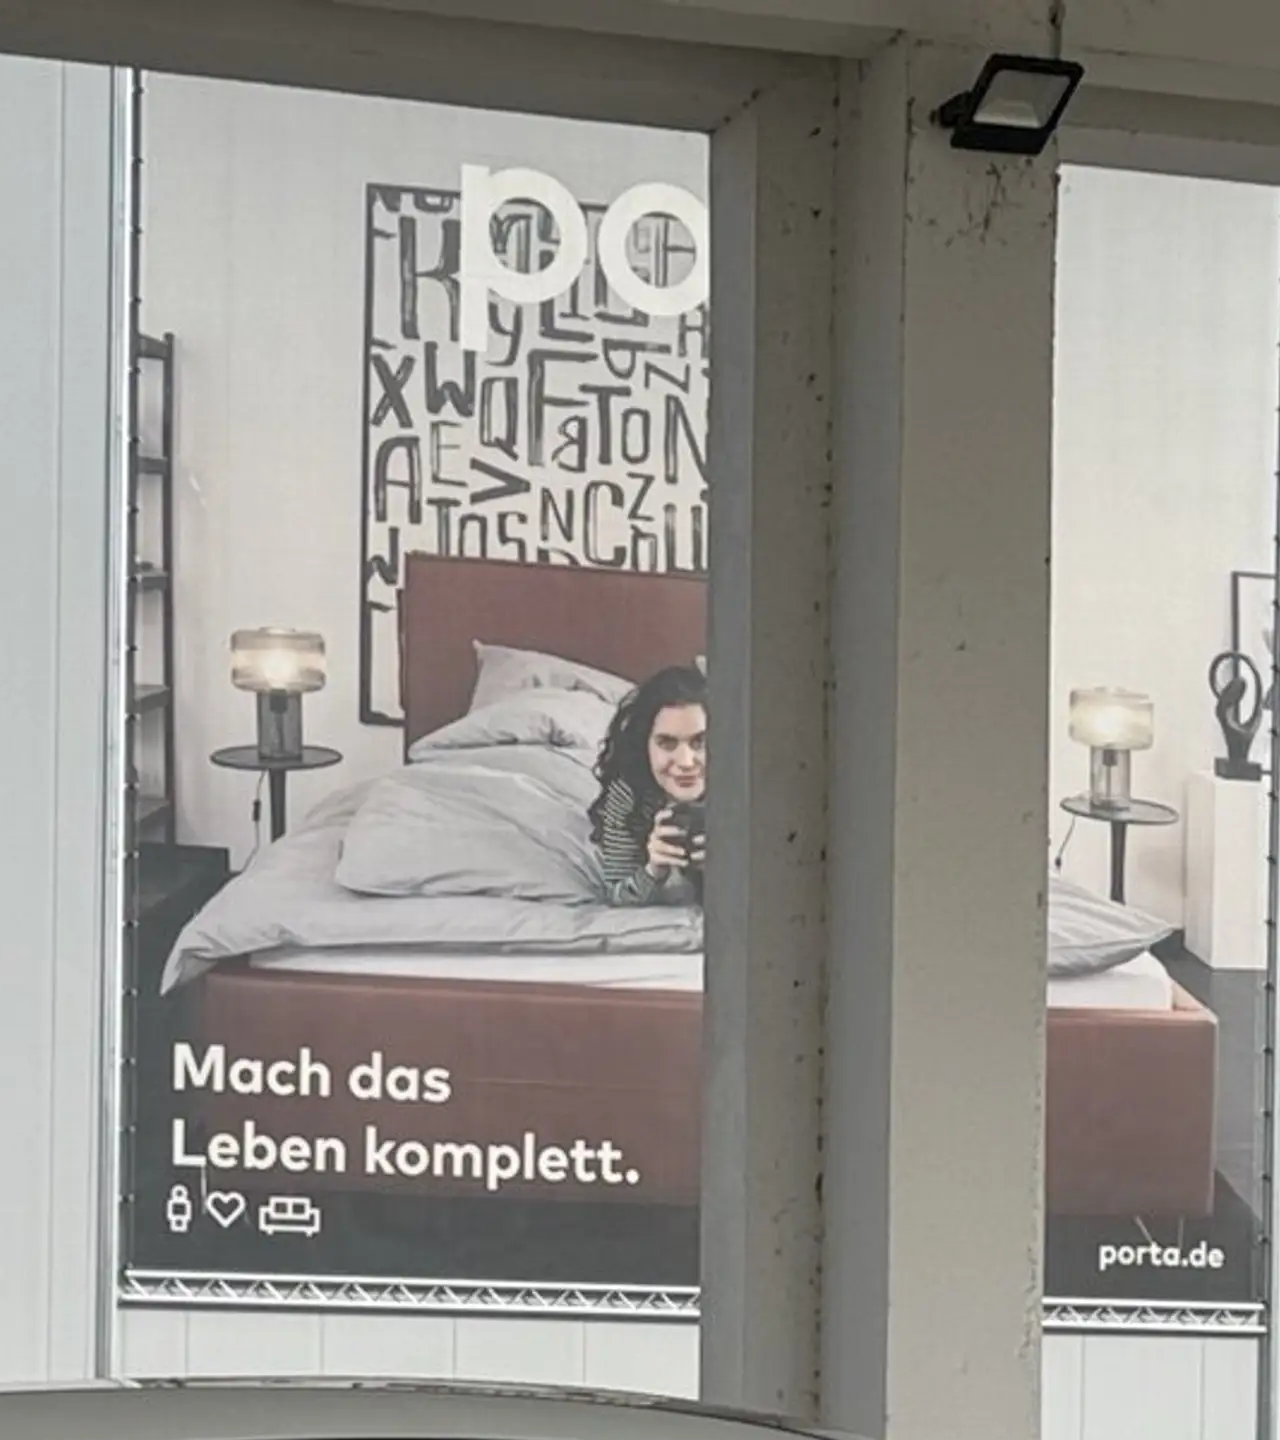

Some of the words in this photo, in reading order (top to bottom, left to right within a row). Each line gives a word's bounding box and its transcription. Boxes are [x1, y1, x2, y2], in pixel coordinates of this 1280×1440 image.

[172, 1042, 331, 1098] Mach
[348, 1051, 453, 1103] das
[171, 1118, 347, 1172] Leben
[364, 1125, 641, 1191] komplett.
[1099, 1240, 1225, 1271] porta.de
